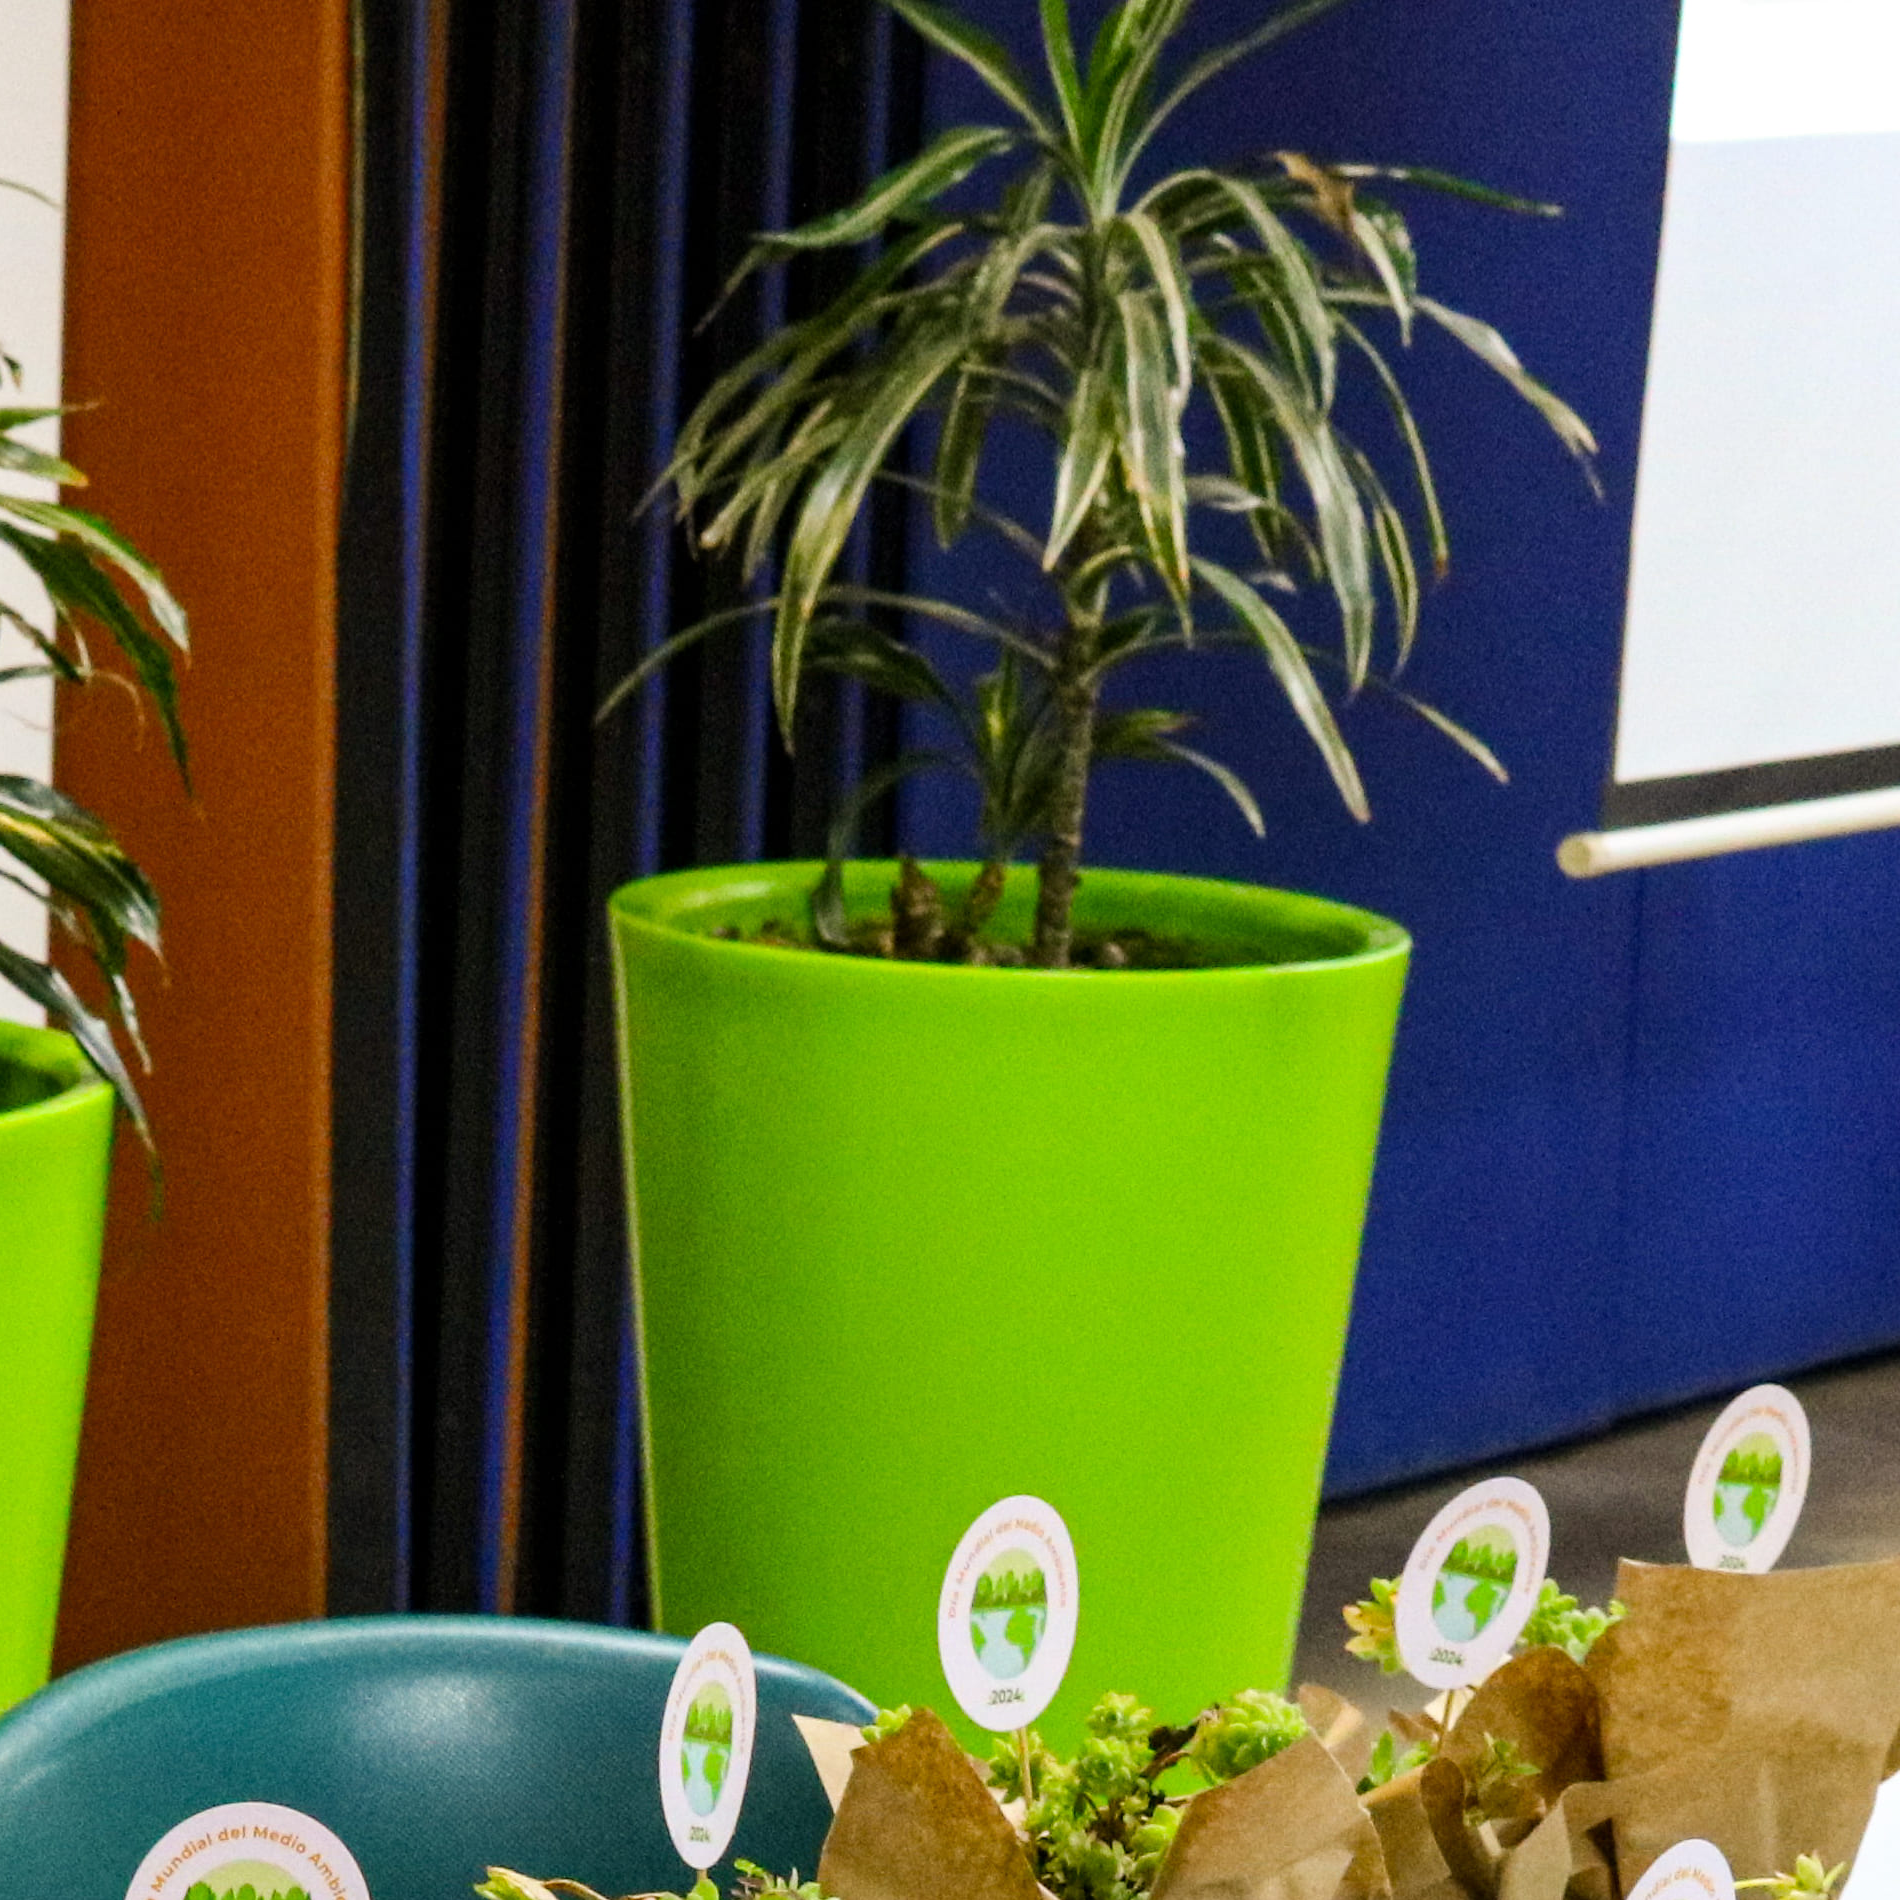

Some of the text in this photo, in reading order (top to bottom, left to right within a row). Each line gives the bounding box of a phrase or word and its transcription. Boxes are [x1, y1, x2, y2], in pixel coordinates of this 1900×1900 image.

[151, 1833, 212, 1893] Mundial
[217, 1825, 247, 1842] del
[253, 1825, 307, 1855] Medio
